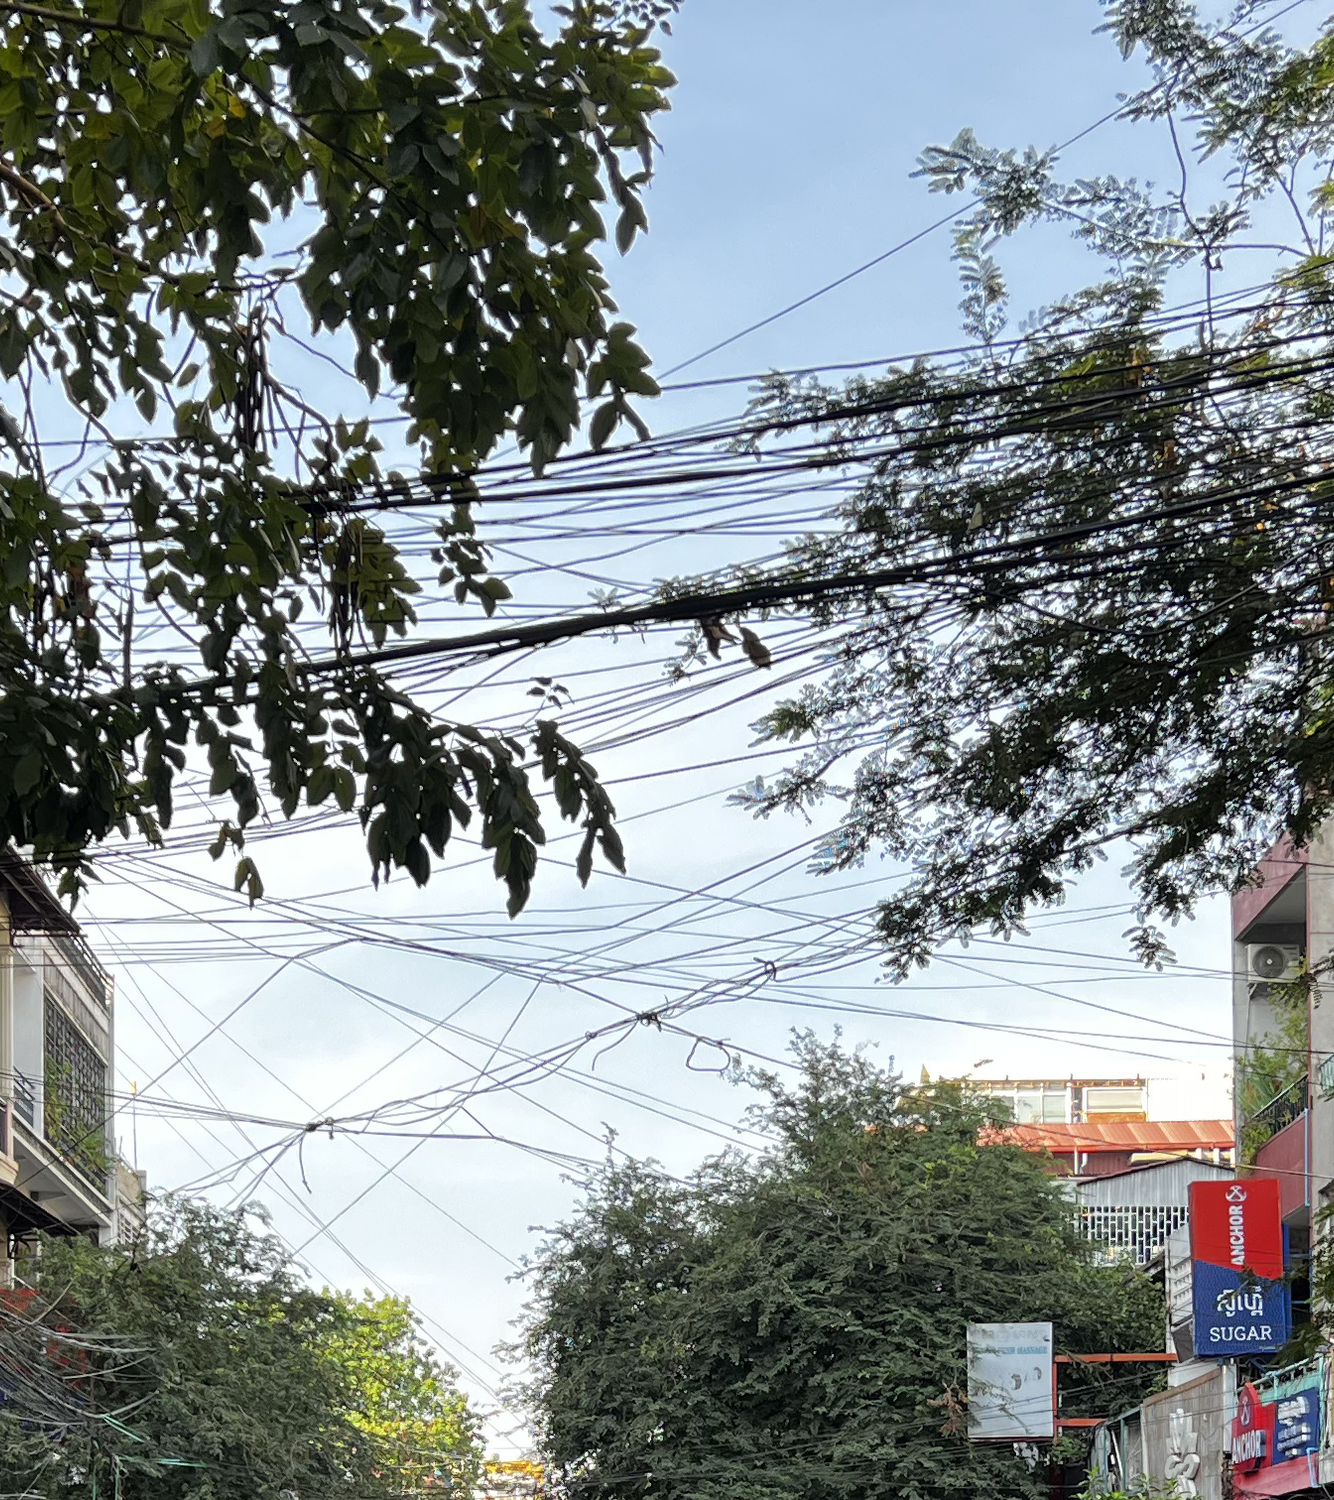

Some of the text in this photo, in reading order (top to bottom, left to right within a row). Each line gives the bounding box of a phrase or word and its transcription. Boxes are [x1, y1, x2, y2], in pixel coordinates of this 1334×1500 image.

[1229, 1206, 1245, 1265] ANCHOR
[1210, 1325, 1272, 1341] SUGAR
[1232, 1430, 1267, 1464] ANCHOR
